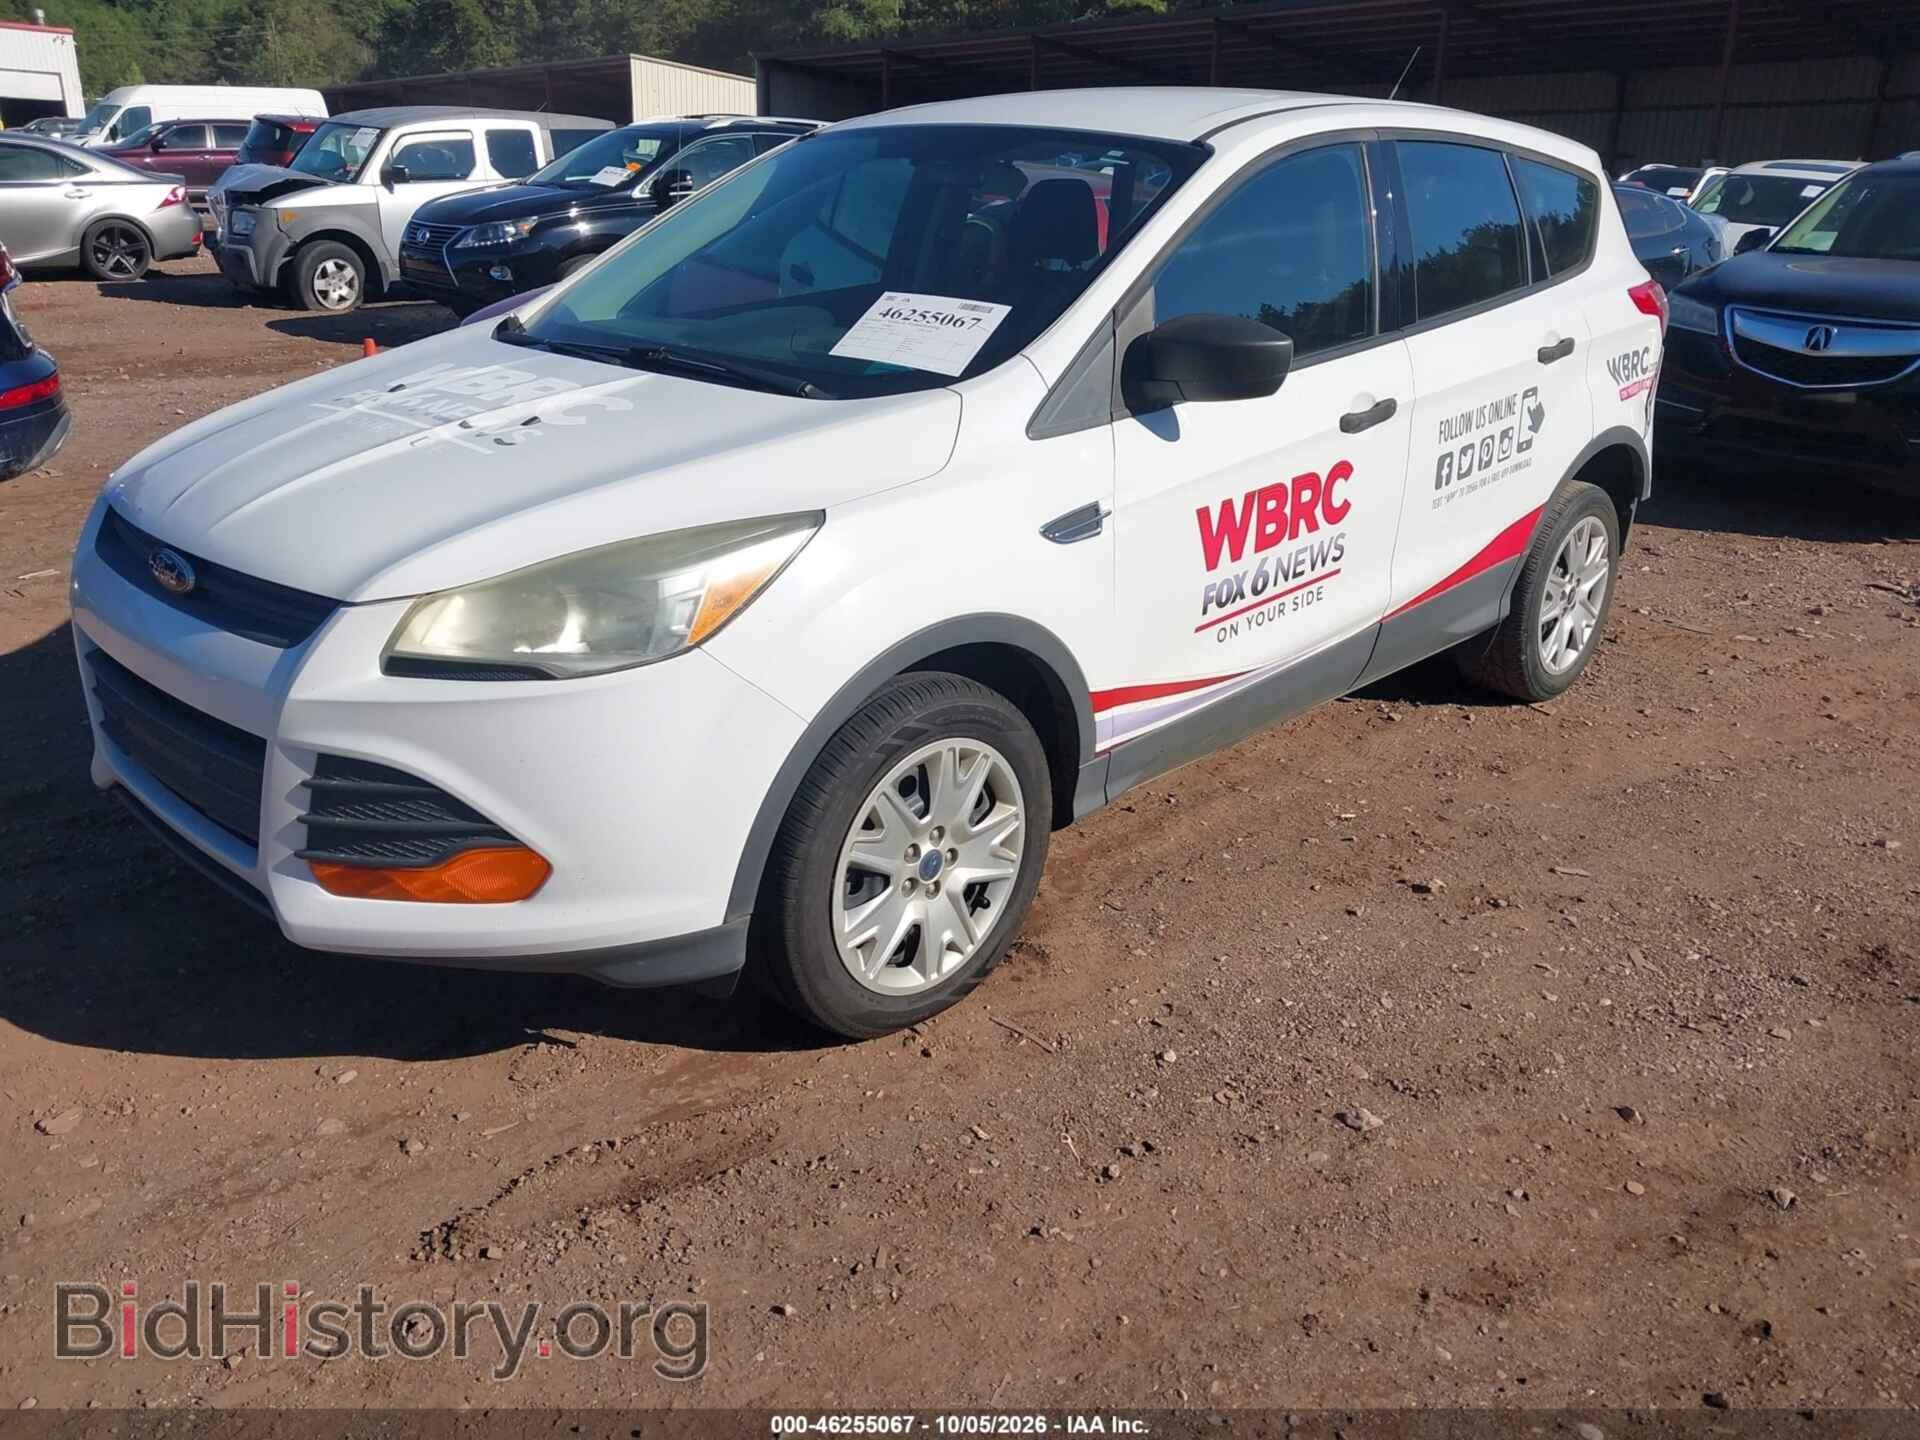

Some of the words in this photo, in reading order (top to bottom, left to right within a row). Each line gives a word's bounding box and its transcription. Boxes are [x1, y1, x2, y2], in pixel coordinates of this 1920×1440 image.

[879, 308, 983, 330] 46255067
[1606, 346, 1650, 385] WBRC
[1438, 410, 1474, 444] FOLLOW
[1475, 405, 1487, 430] US
[1488, 393, 1517, 424] ONLINE
[1196, 460, 1354, 572] WBRC
[1201, 569, 1249, 616] FOX
[1250, 556, 1271, 597] 6
[1273, 532, 1347, 587] NEWS
[1216, 621, 1240, 643] ON
[1246, 602, 1286, 630] YOUR
[1292, 585, 1325, 612] SIDE
